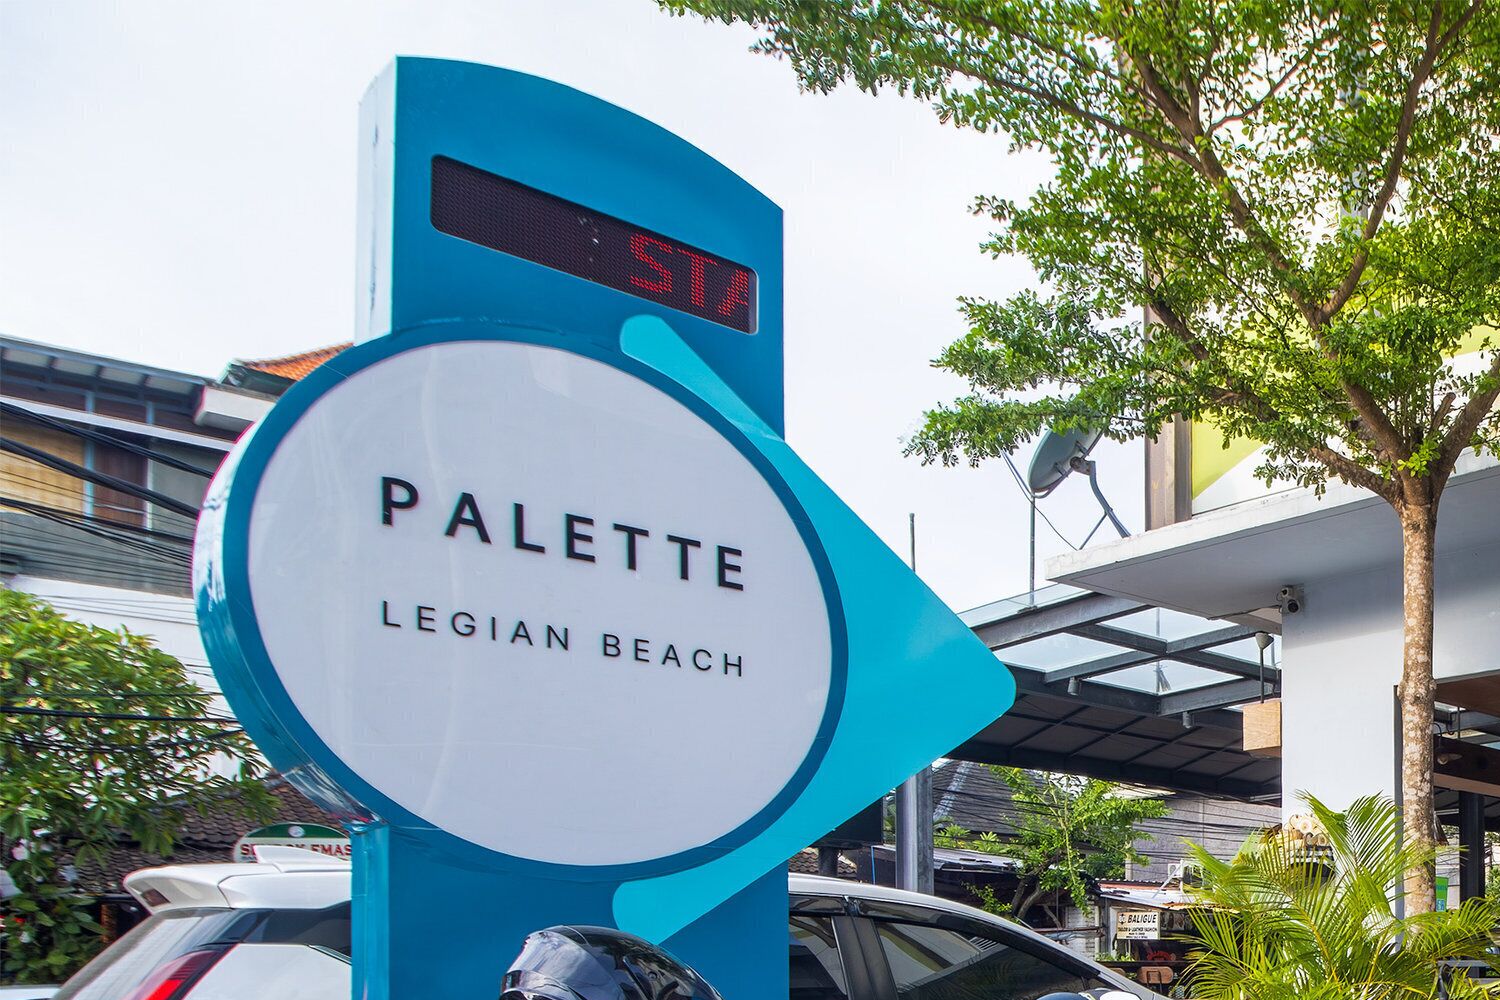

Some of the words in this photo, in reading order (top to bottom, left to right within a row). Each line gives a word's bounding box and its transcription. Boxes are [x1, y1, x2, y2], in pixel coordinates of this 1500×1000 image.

[381, 476, 744, 591] PALETTE
[383, 600, 568, 651] LEGIAN
[602, 633, 743, 677] BEACH
[1128, 914, 1156, 923] BALIGUE
